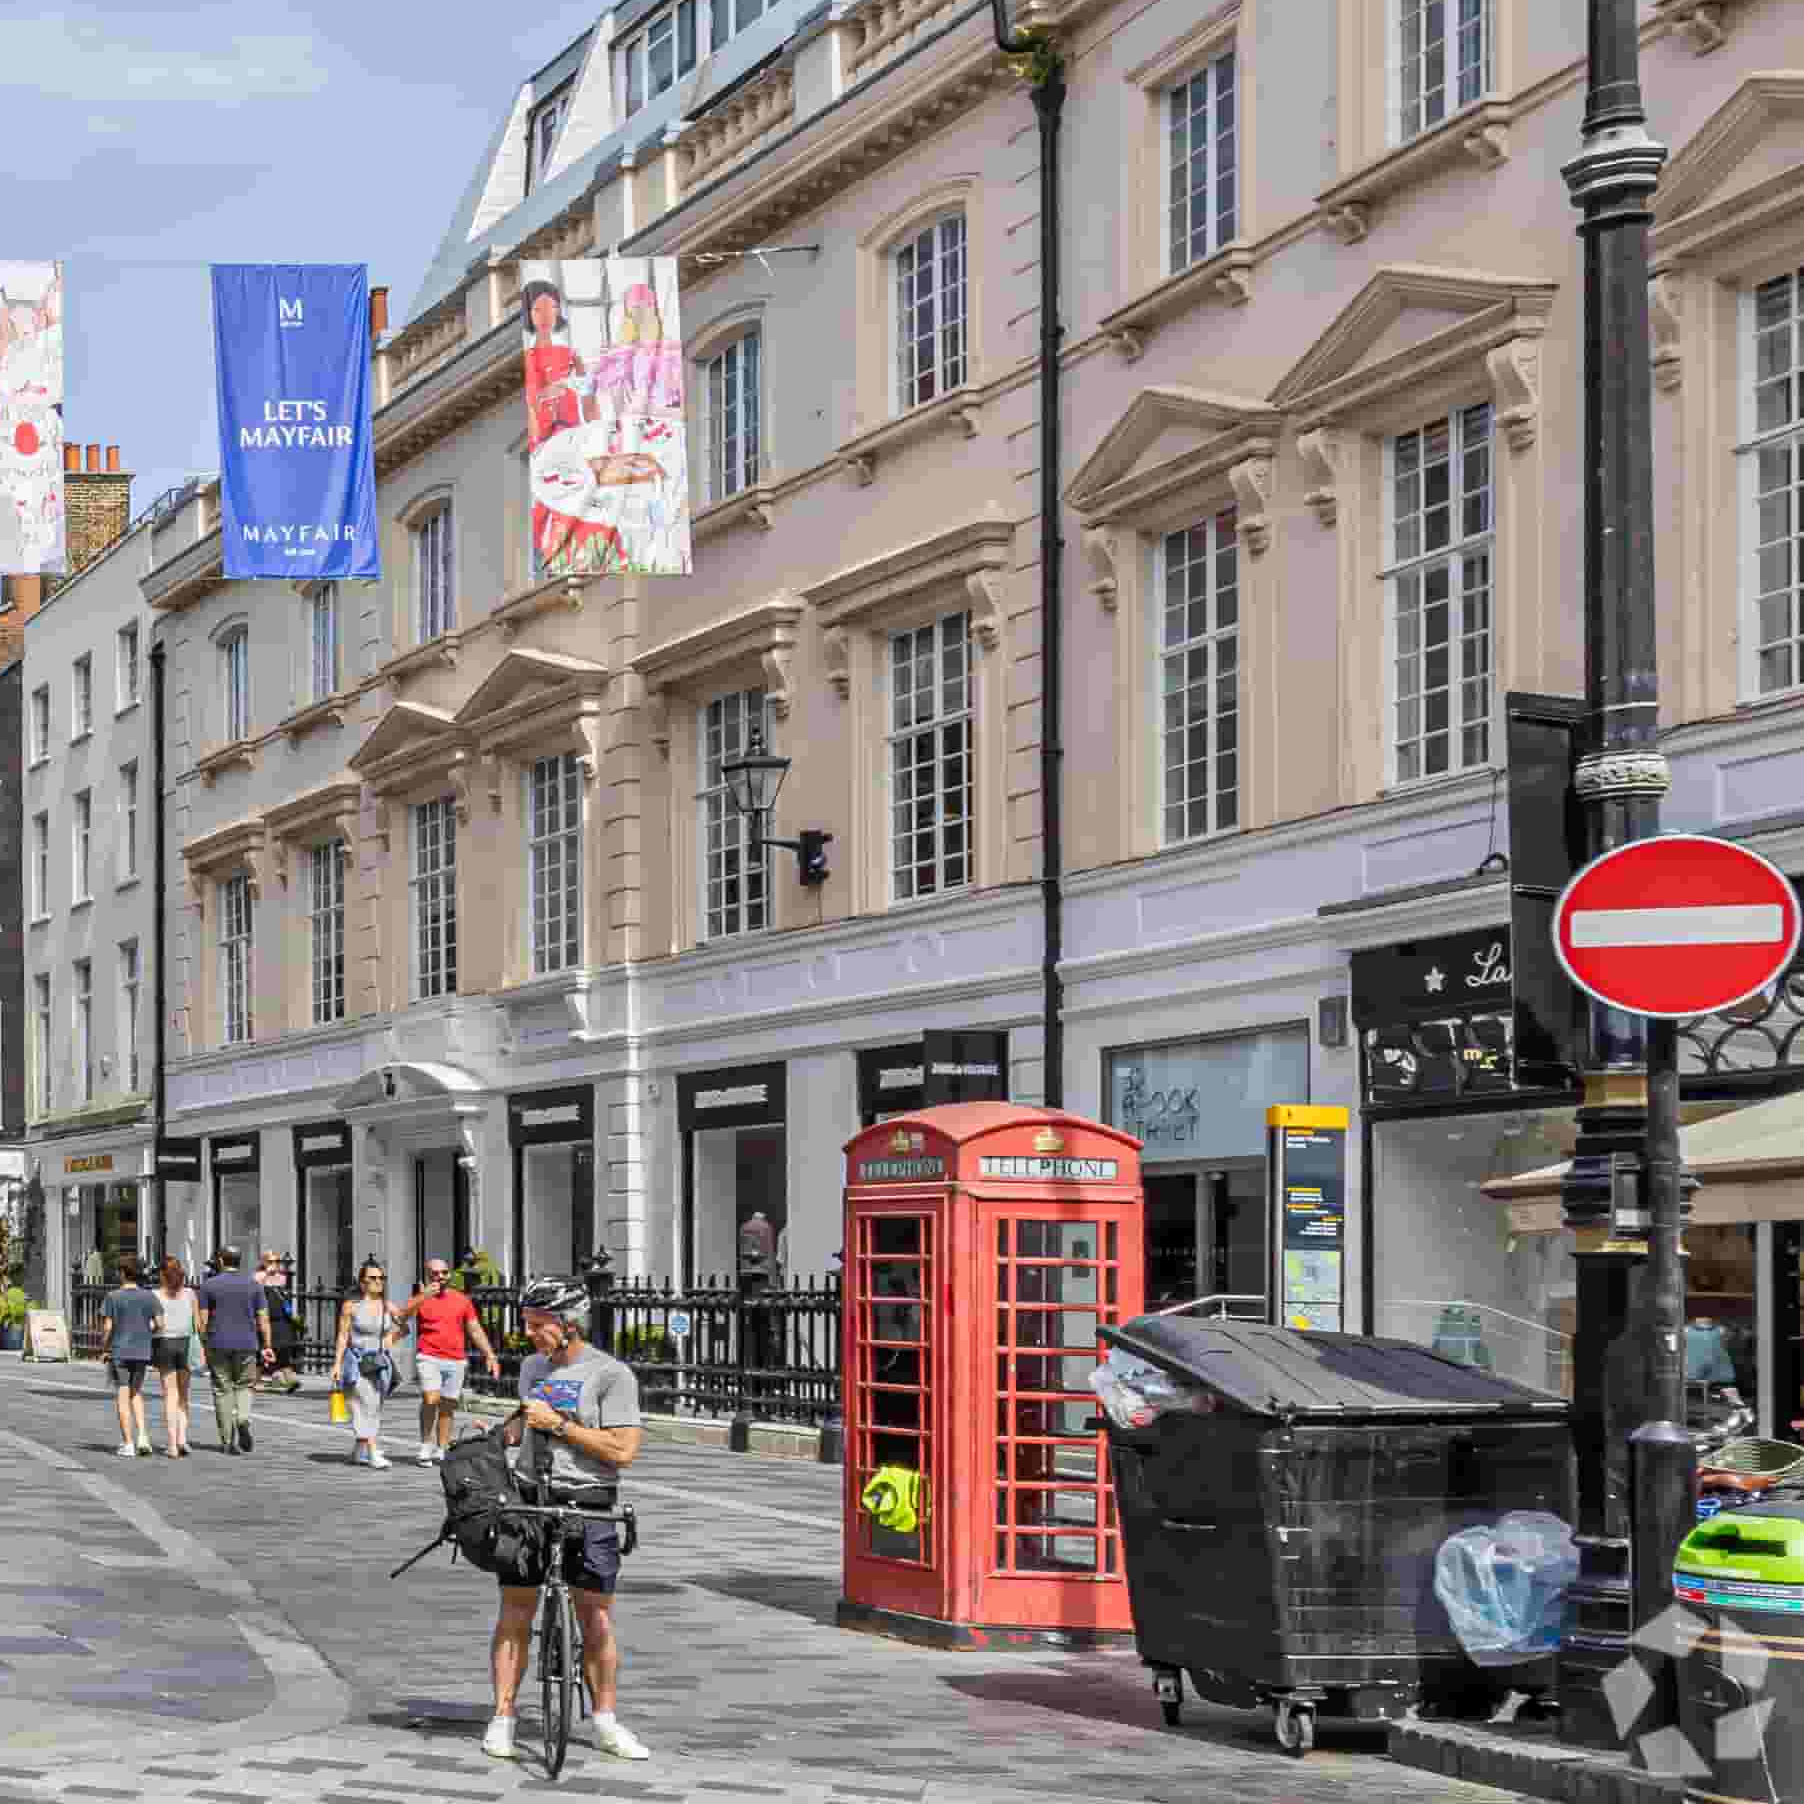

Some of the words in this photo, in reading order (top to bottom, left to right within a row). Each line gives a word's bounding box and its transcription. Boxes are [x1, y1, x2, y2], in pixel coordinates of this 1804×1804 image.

[279, 297, 304, 320] M
[263, 400, 329, 421] LET'S
[239, 425, 354, 448] MAYFAIR
[242, 523, 356, 542] MAYFAIR
